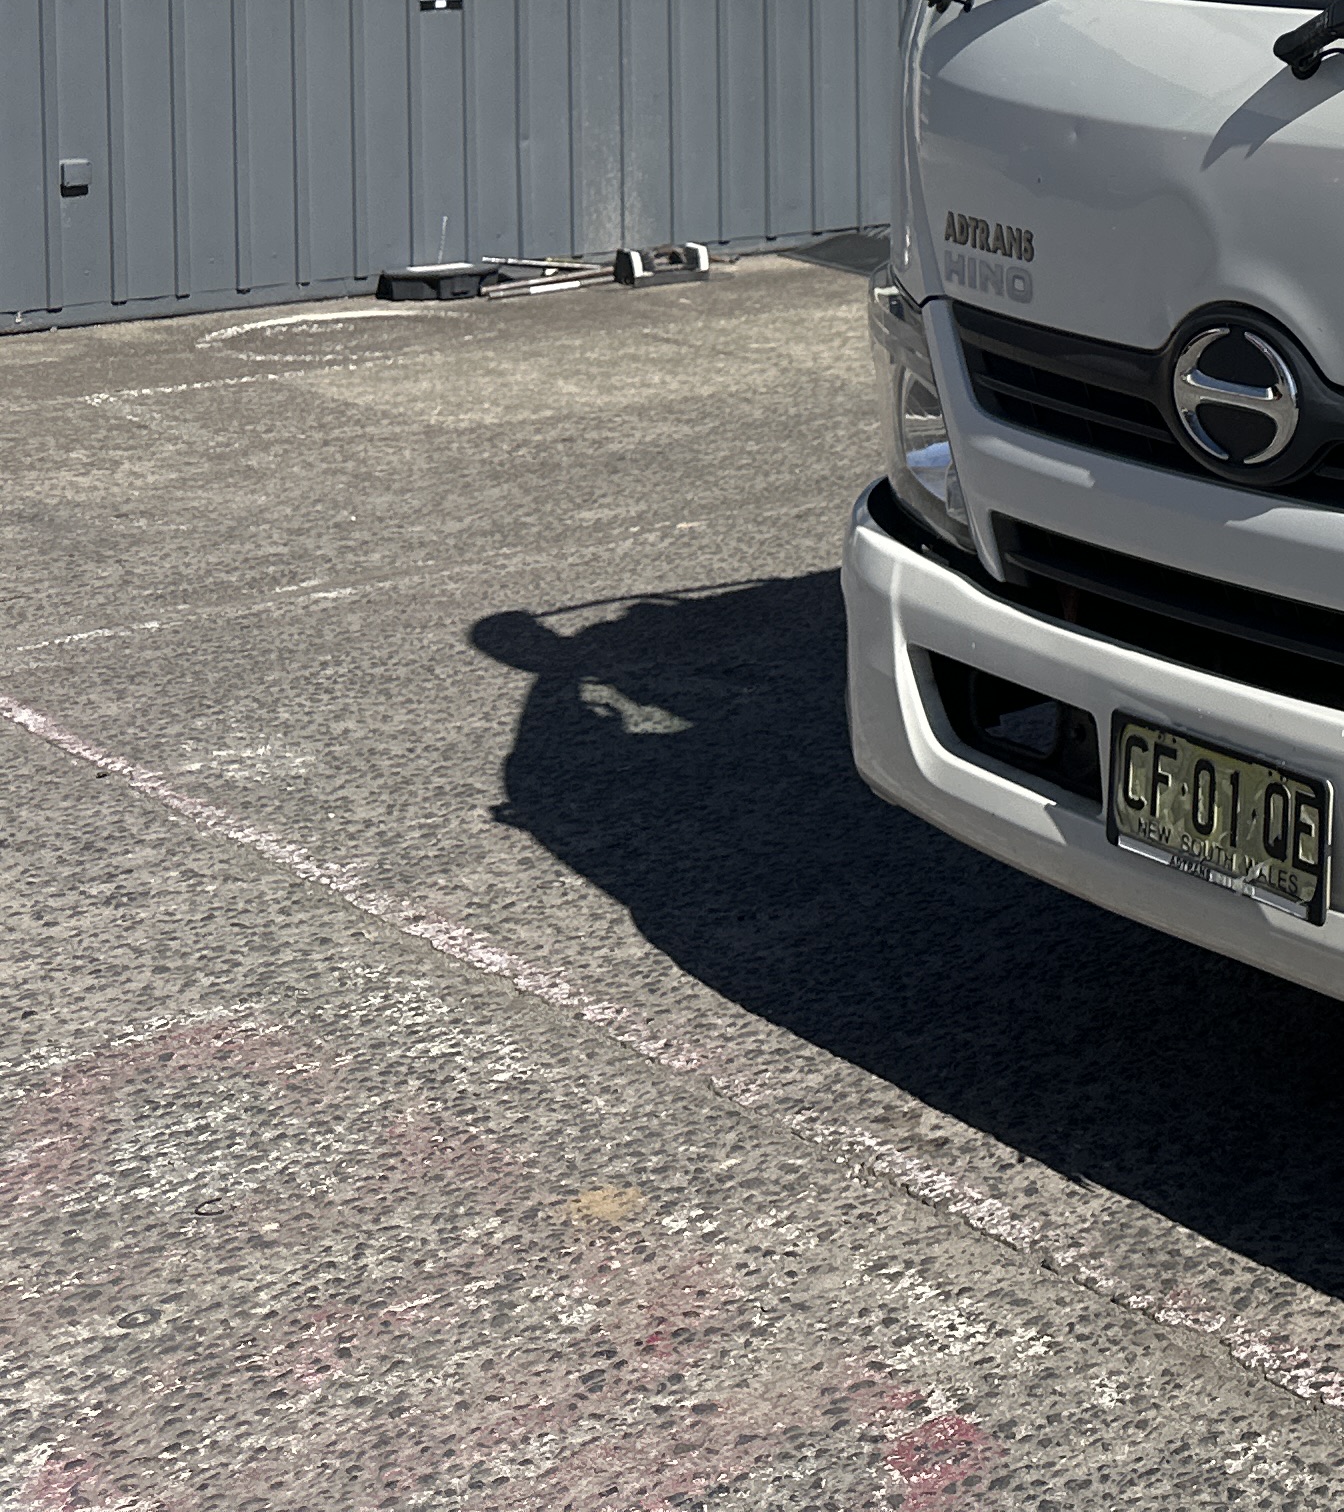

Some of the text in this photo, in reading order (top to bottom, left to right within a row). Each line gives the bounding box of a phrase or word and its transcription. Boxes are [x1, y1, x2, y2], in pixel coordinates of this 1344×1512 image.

[944, 210, 1035, 263] ADTRANS
[944, 250, 1033, 304] HINO
[1138, 817, 1171, 844] NEW
[1181, 833, 1237, 870] SOUTH
